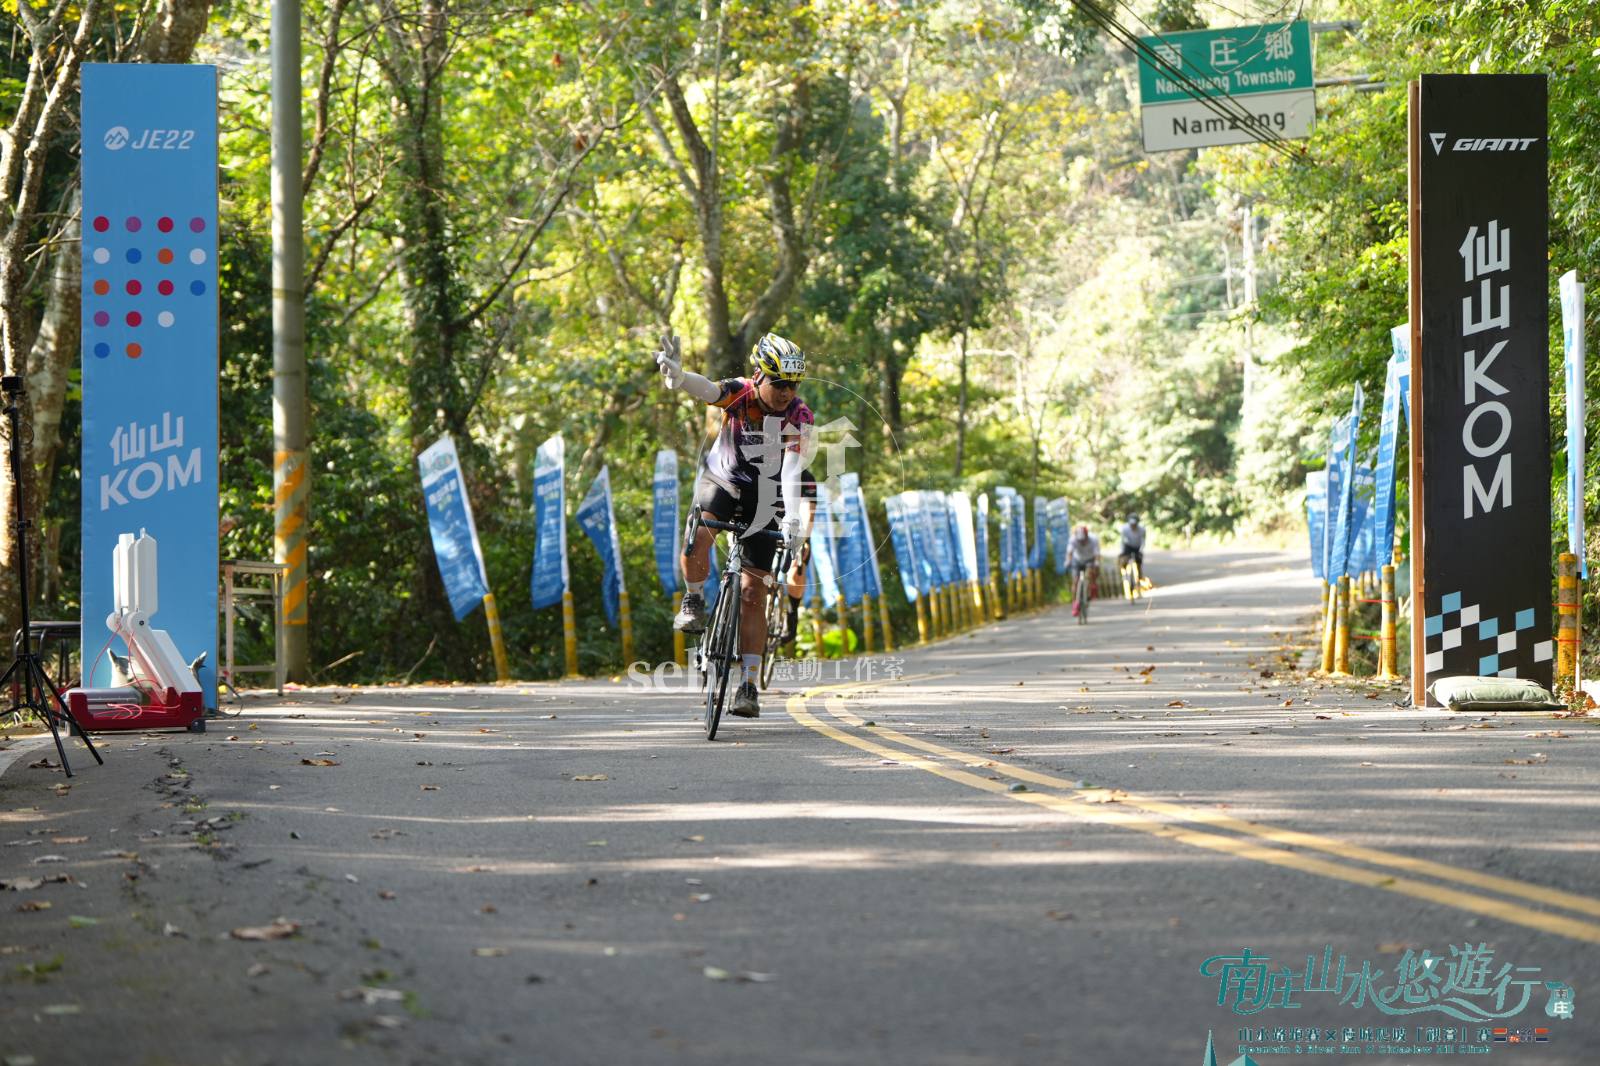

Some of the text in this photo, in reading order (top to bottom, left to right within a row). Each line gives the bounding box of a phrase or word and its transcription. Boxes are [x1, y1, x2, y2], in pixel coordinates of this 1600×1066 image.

[1153, 29, 1294, 70] 南庄鄉
[1234, 67, 1296, 88] Township
[131, 129, 195, 150] JE22
[1172, 111, 1286, 137] Namzong
[1452, 137, 1540, 152] GIANT
[1459, 219, 1512, 520] 仙山 KOM
[109, 411, 184, 466] 仙山
[100, 447, 202, 512] KOM
